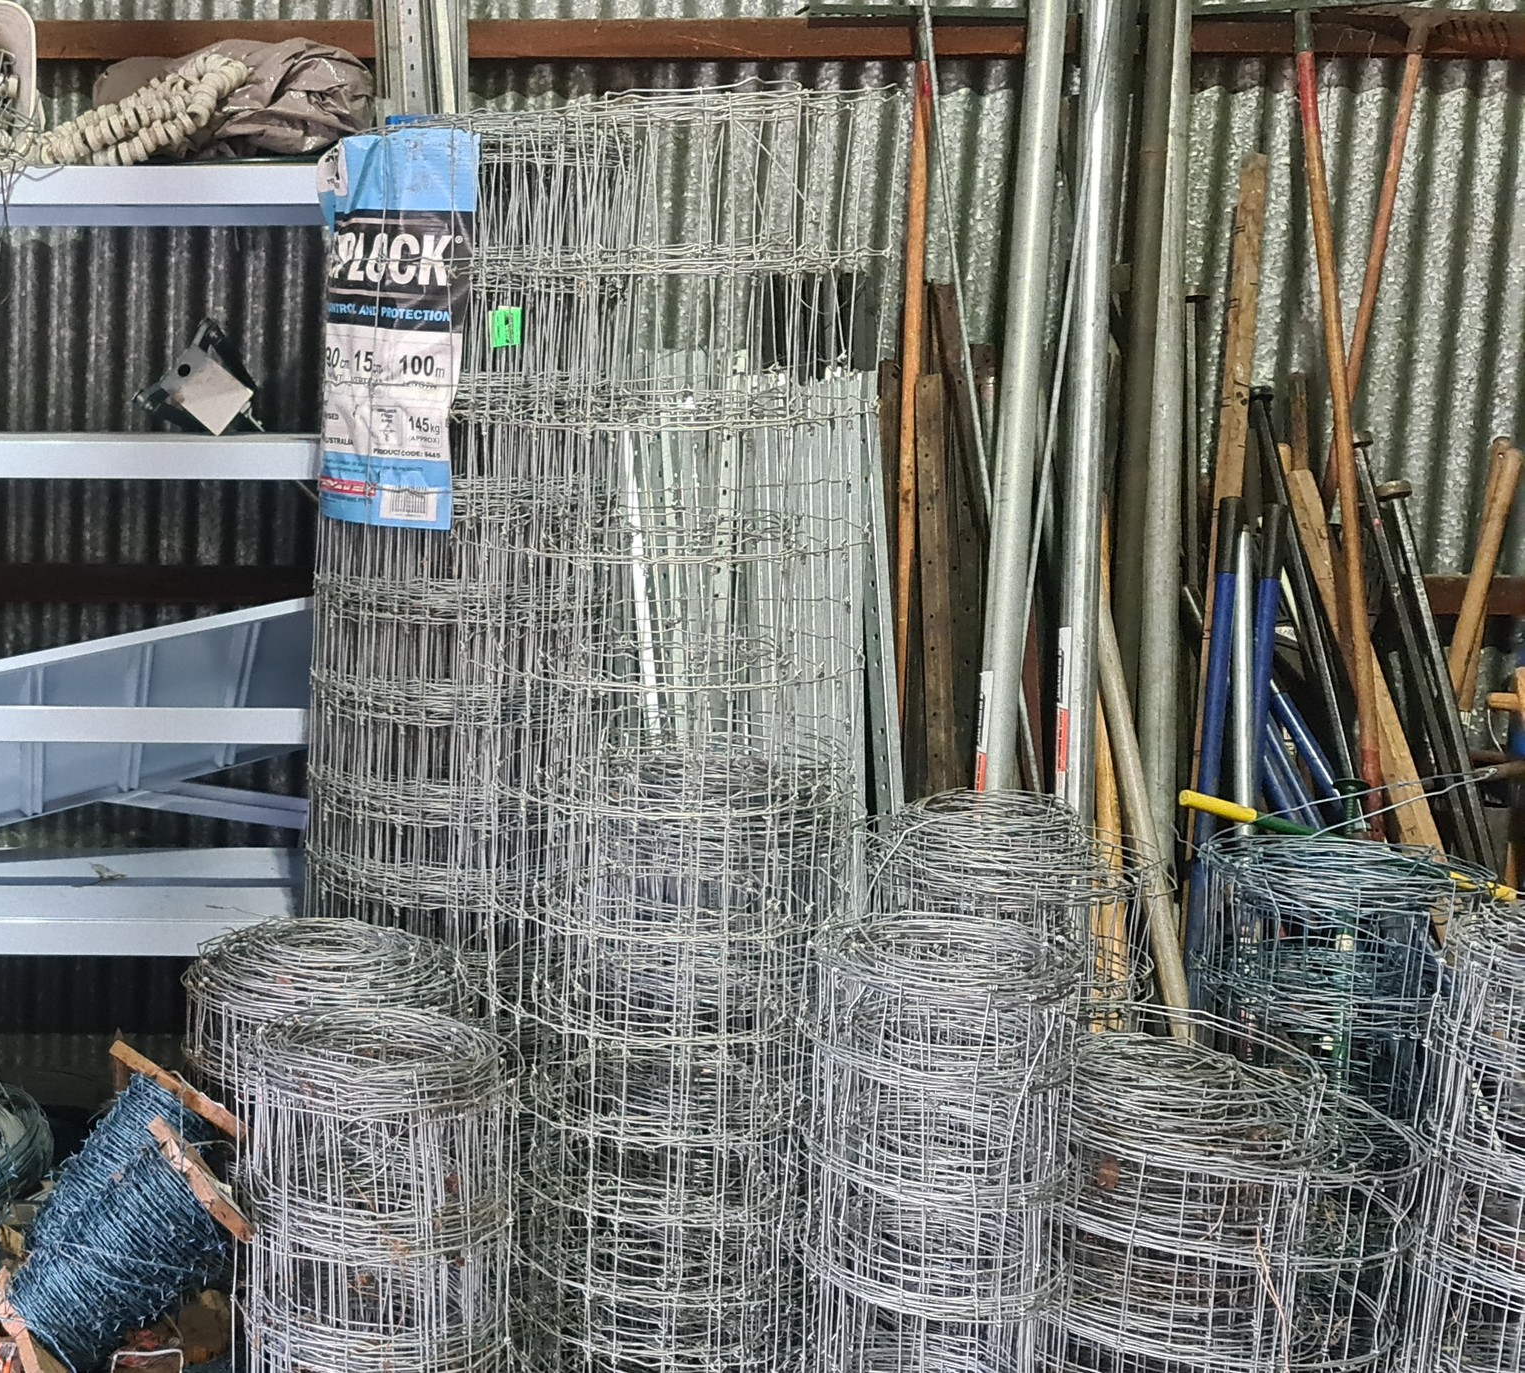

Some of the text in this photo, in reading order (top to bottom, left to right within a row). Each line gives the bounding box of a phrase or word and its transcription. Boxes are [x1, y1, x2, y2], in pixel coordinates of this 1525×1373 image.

[358, 305, 377, 317] AND
[380, 306, 451, 322] PROTECTION
[373, 448, 400, 456] PRODUCT
[401, 449, 423, 458] CODE:
